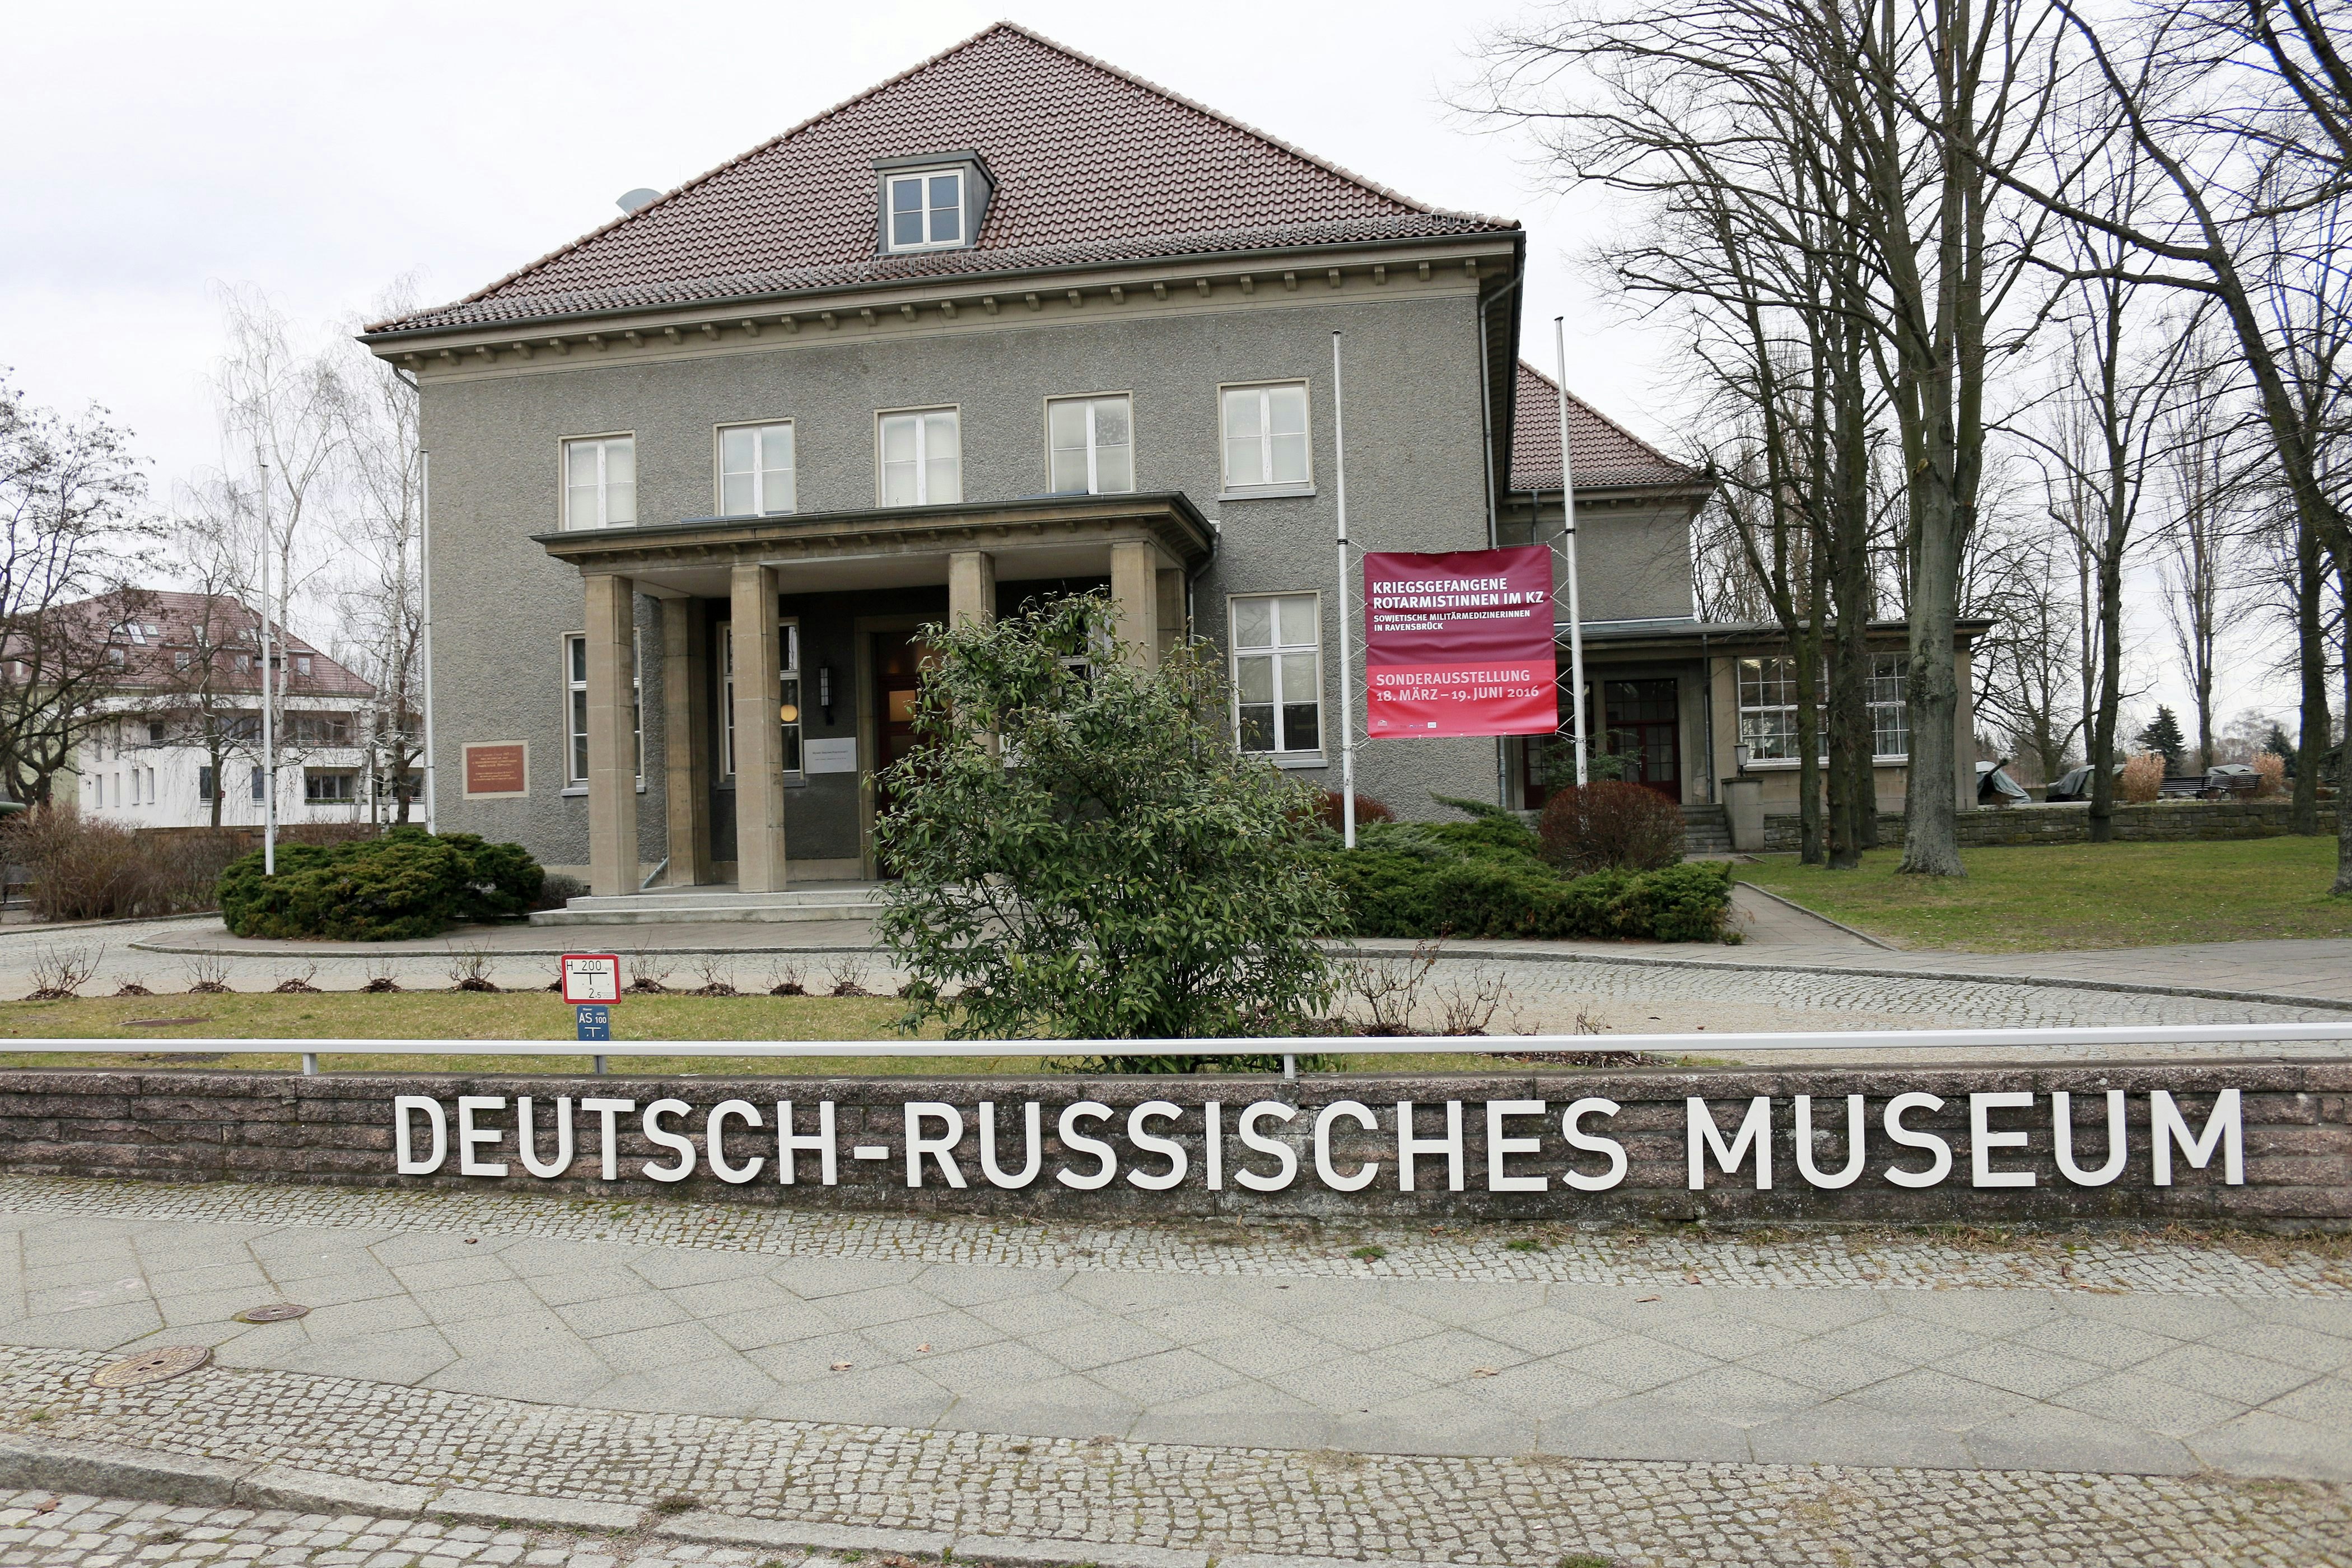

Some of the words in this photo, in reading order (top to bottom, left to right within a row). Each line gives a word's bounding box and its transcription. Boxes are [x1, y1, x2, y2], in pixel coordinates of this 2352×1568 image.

[1373, 577, 1508, 594] KRIEGSGEFANGENE
[1373, 593, 1499, 609] ROTARMISTINNEN
[1504, 592, 1521, 605] IM
[1525, 591, 1544, 604] KZ
[1374, 613, 1427, 623] SOWJETISCHE
[1429, 609, 1530, 621] MILITÄRMEDIZINERINNEN
[1384, 622, 1443, 632] RAVENSBRÜCK
[1376, 670, 1530, 686] SONDERAUSSTELLUNG
[1376, 690, 1396, 701] 18.
[1400, 687, 1438, 701] MÄRZ
[1451, 690, 1471, 702] 19.
[1472, 686, 1503, 701] JUNI
[1507, 685, 1539, 698] 2016
[566, 960, 573, 970] H
[582, 960, 601, 970] 200
[578, 1012, 592, 1024] AS
[394, 1094, 1628, 1193] DEUTSCH-RUSSISCHES
[1686, 1088, 2246, 1192] MUSEUM
